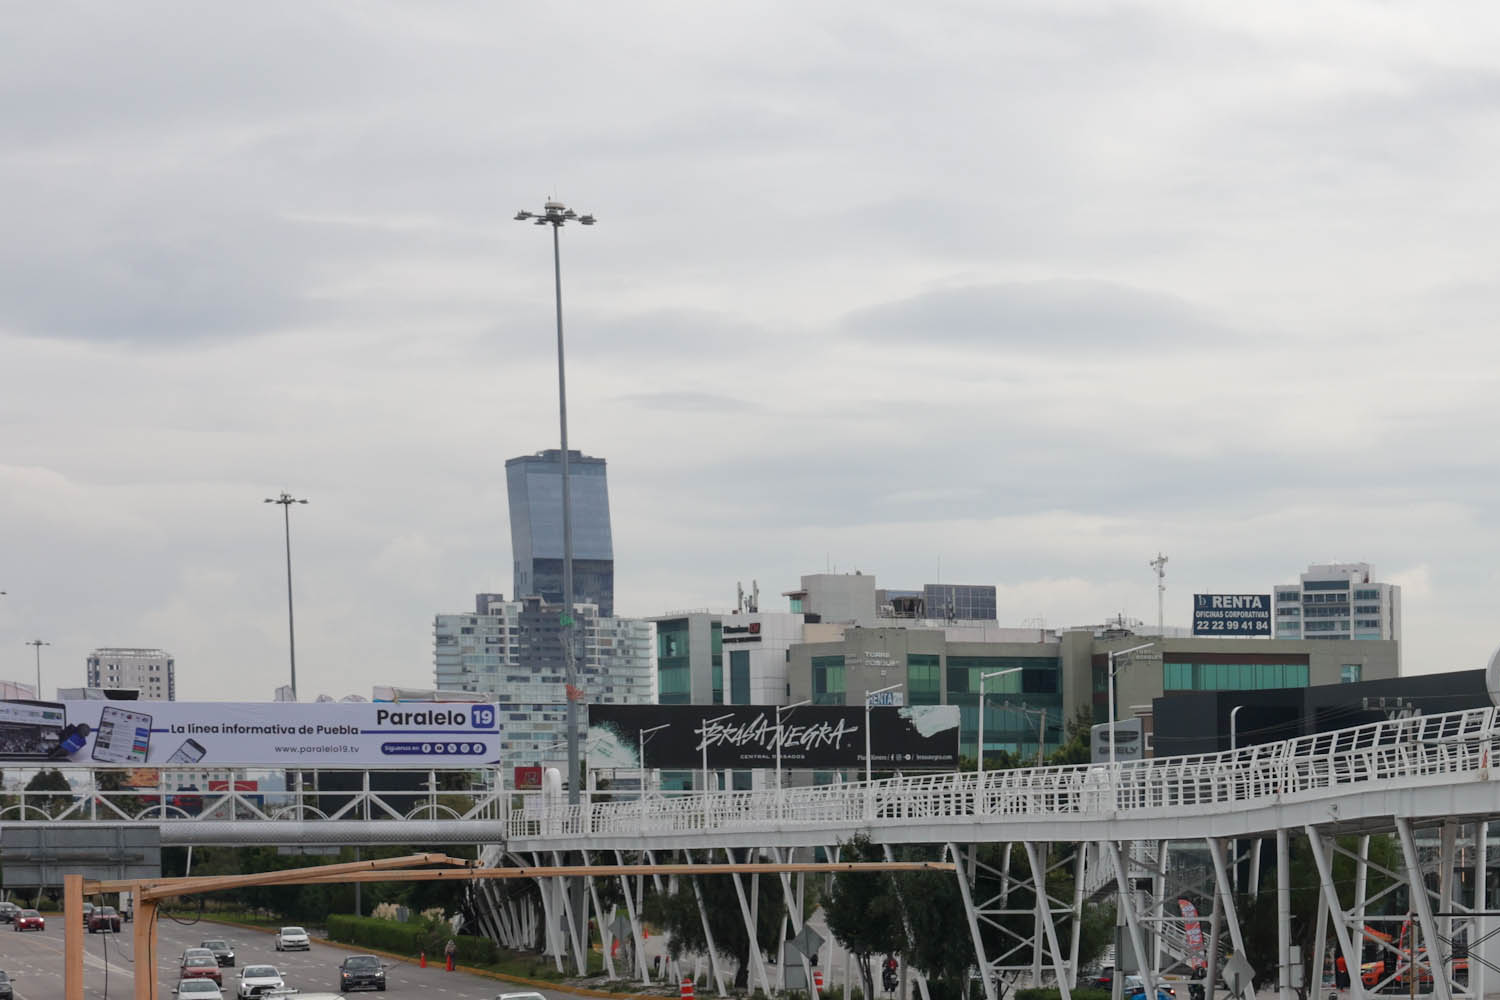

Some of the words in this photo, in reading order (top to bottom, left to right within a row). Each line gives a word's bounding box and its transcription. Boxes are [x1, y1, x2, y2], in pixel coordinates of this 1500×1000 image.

[1212, 595, 1262, 608] RENTA
[1224, 610, 1269, 618] CORPORATIVAS
[1196, 621, 1209, 630] 22
[1211, 621, 1224, 630] 22
[1226, 621, 1239, 630] 99
[1241, 621, 1253, 630] 41
[1256, 621, 1268, 630] 84
[377, 709, 467, 725] Paralelo
[472, 710, 494, 725] 19
[170, 724, 185, 734] La
[187, 723, 219, 734] línea
[222, 723, 296, 735] informativa
[298, 724, 314, 735] de
[316, 725, 359, 735] Puebla
[694, 712, 775, 751] BRASA
[274, 745, 359, 754] www.paralelo19.tv
[1099, 746, 1138, 754] GELY
